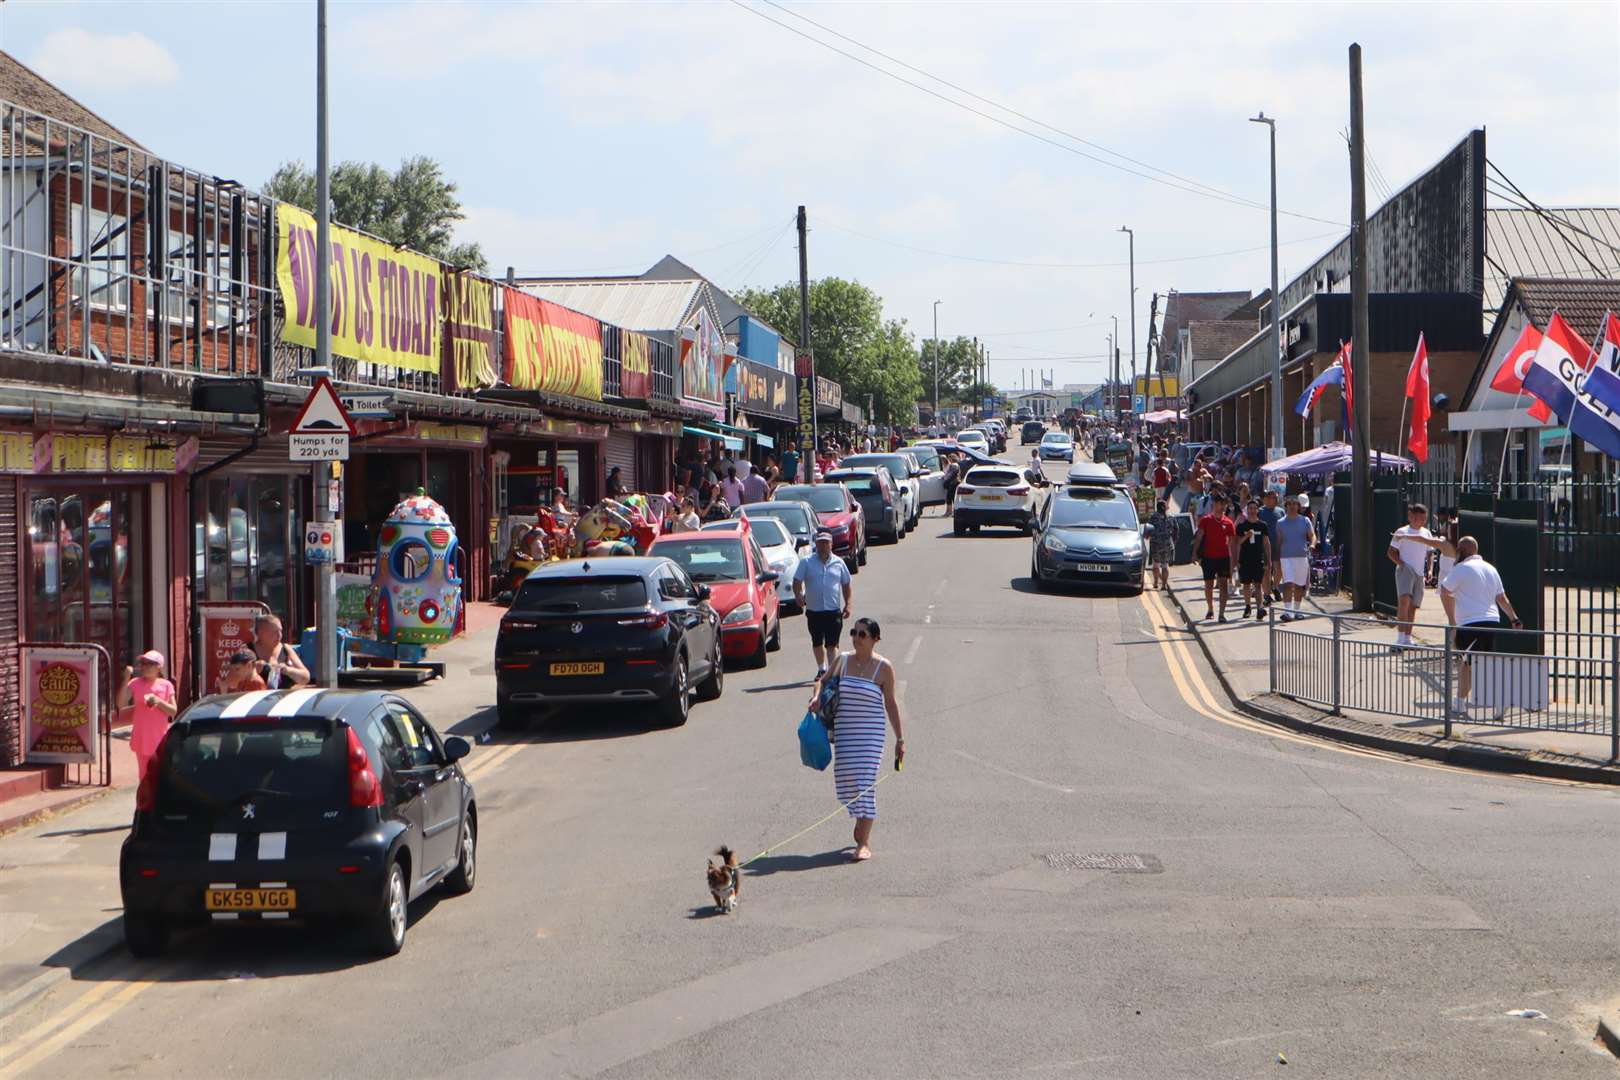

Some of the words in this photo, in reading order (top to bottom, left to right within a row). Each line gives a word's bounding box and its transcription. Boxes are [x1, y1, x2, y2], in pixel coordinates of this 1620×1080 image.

[351, 247, 374, 348] US
[377, 258, 436, 357] TODAY
[293, 437, 325, 446] Humps
[331, 436, 344, 445] for
[52, 433, 107, 473] PRIZE
[300, 448, 320, 456] 220
[322, 447, 340, 457] yds
[553, 665, 578, 674] FD70
[212, 892, 254, 906] GK59
